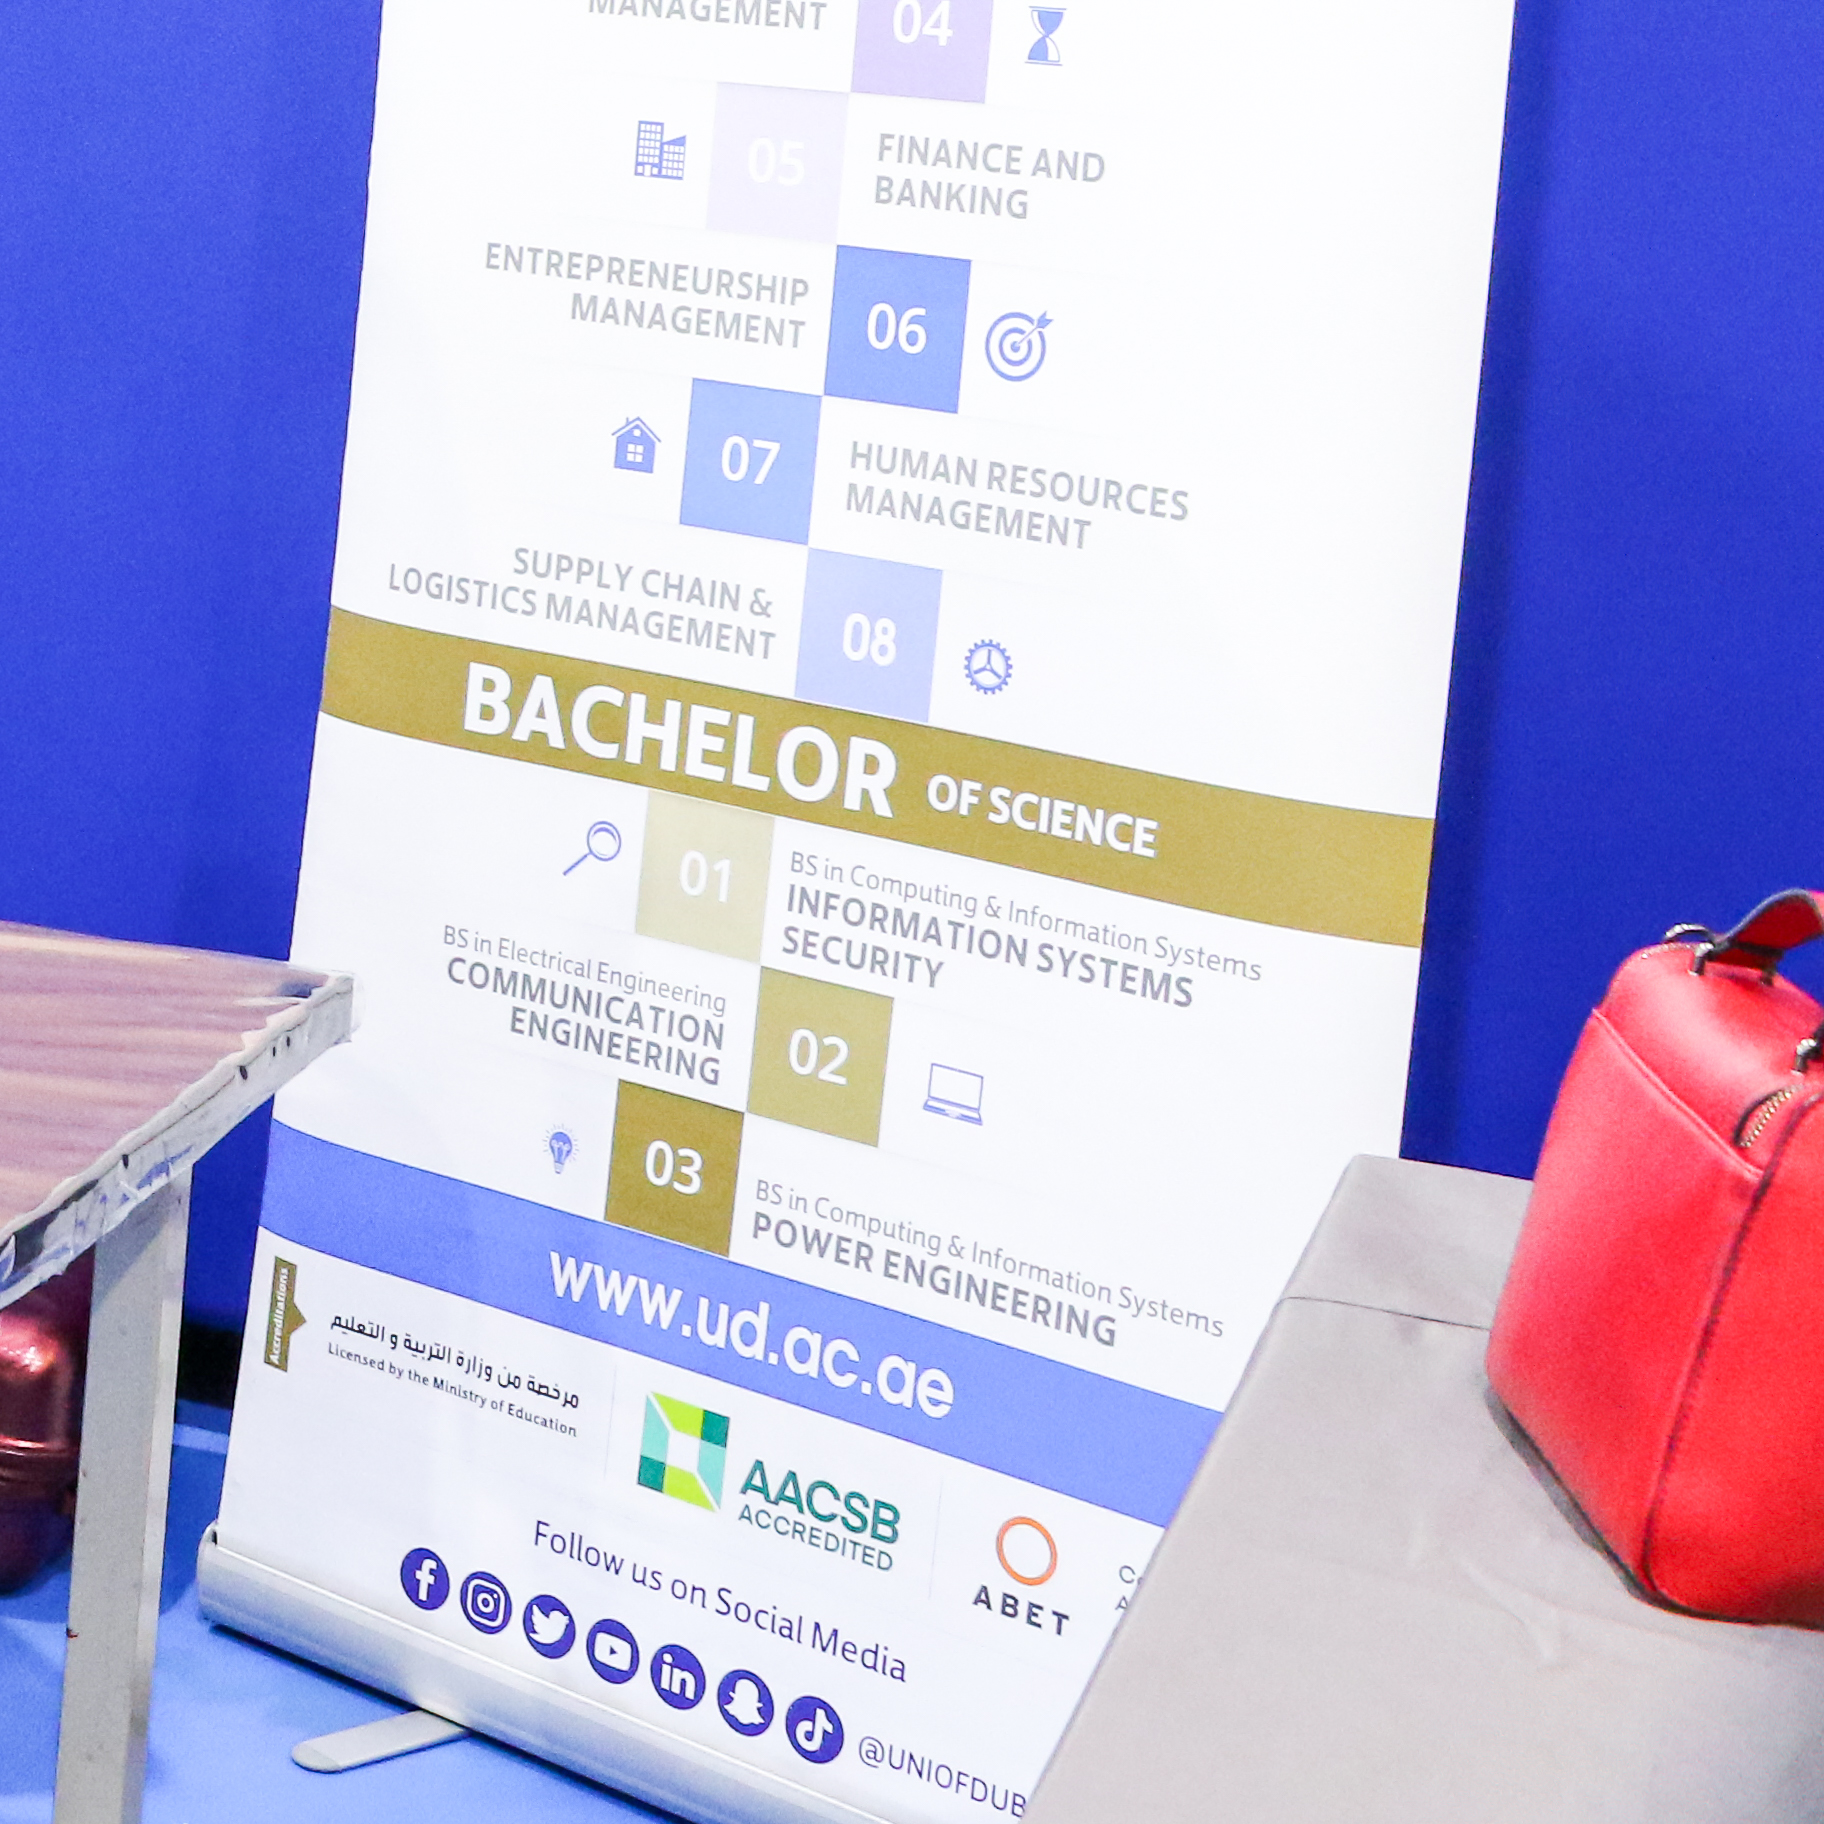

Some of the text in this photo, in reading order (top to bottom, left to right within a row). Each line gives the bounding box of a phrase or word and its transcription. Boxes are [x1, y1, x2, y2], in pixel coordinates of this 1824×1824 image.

[747, 137, 806, 187] 05
[877, 132, 1106, 184] FINANCE AND
[874, 175, 1030, 221] BANKING
[484, 242, 810, 307] ENTREPRENEURSHIP
[569, 292, 806, 350] MANAGEMENT
[866, 302, 928, 355] 06
[719, 435, 781, 486] 07
[850, 440, 1189, 523] HUMAN RESOURCES
[846, 482, 1092, 551] MANAGEMENT
[387, 562, 777, 662] LOGISTICS MANAGEMENT
[514, 546, 774, 620] SUPPLY CHAIN &
[841, 611, 899, 667] 08
[464, 660, 1159, 859] BACHELOR OF SCIENCE
[679, 849, 734, 904] 01
[786, 882, 1195, 1010] INFORMATION SYSTEMS
[790, 851, 1263, 983] BS in Computing & Information Systems
[443, 924, 727, 1020] BS in Electrical Engineering
[782, 925, 945, 990] SECURITY
[446, 955, 724, 1052] COMMUNICATION
[509, 1006, 721, 1087] ENGINEERING
[787, 1028, 849, 1086] 02
[642, 1139, 704, 1195] 03
[752, 1211, 1118, 1349] POWER ENGINEERING
[755, 1179, 1225, 1339] BS in Computing & Information Systems
[267, 1267, 289, 1364] Accreditations
[331, 1314, 385, 1344] التعليم
[404, 1332, 451, 1362] التربية
[548, 1247, 955, 1418] www.ud.ac.ae
[328, 1342, 577, 1437] Licensed by the Ministry of Education
[456, 1352, 492, 1382] وزارة
[498, 1365, 521, 1390] من
[527, 1380, 579, 1409] مرخصة
[740, 1459, 900, 1545] AACSB
[738, 1504, 893, 1572] ACCREDITED
[534, 1520, 907, 1682] Follow us on Social Media
[972, 1585, 1070, 1637] ABET
